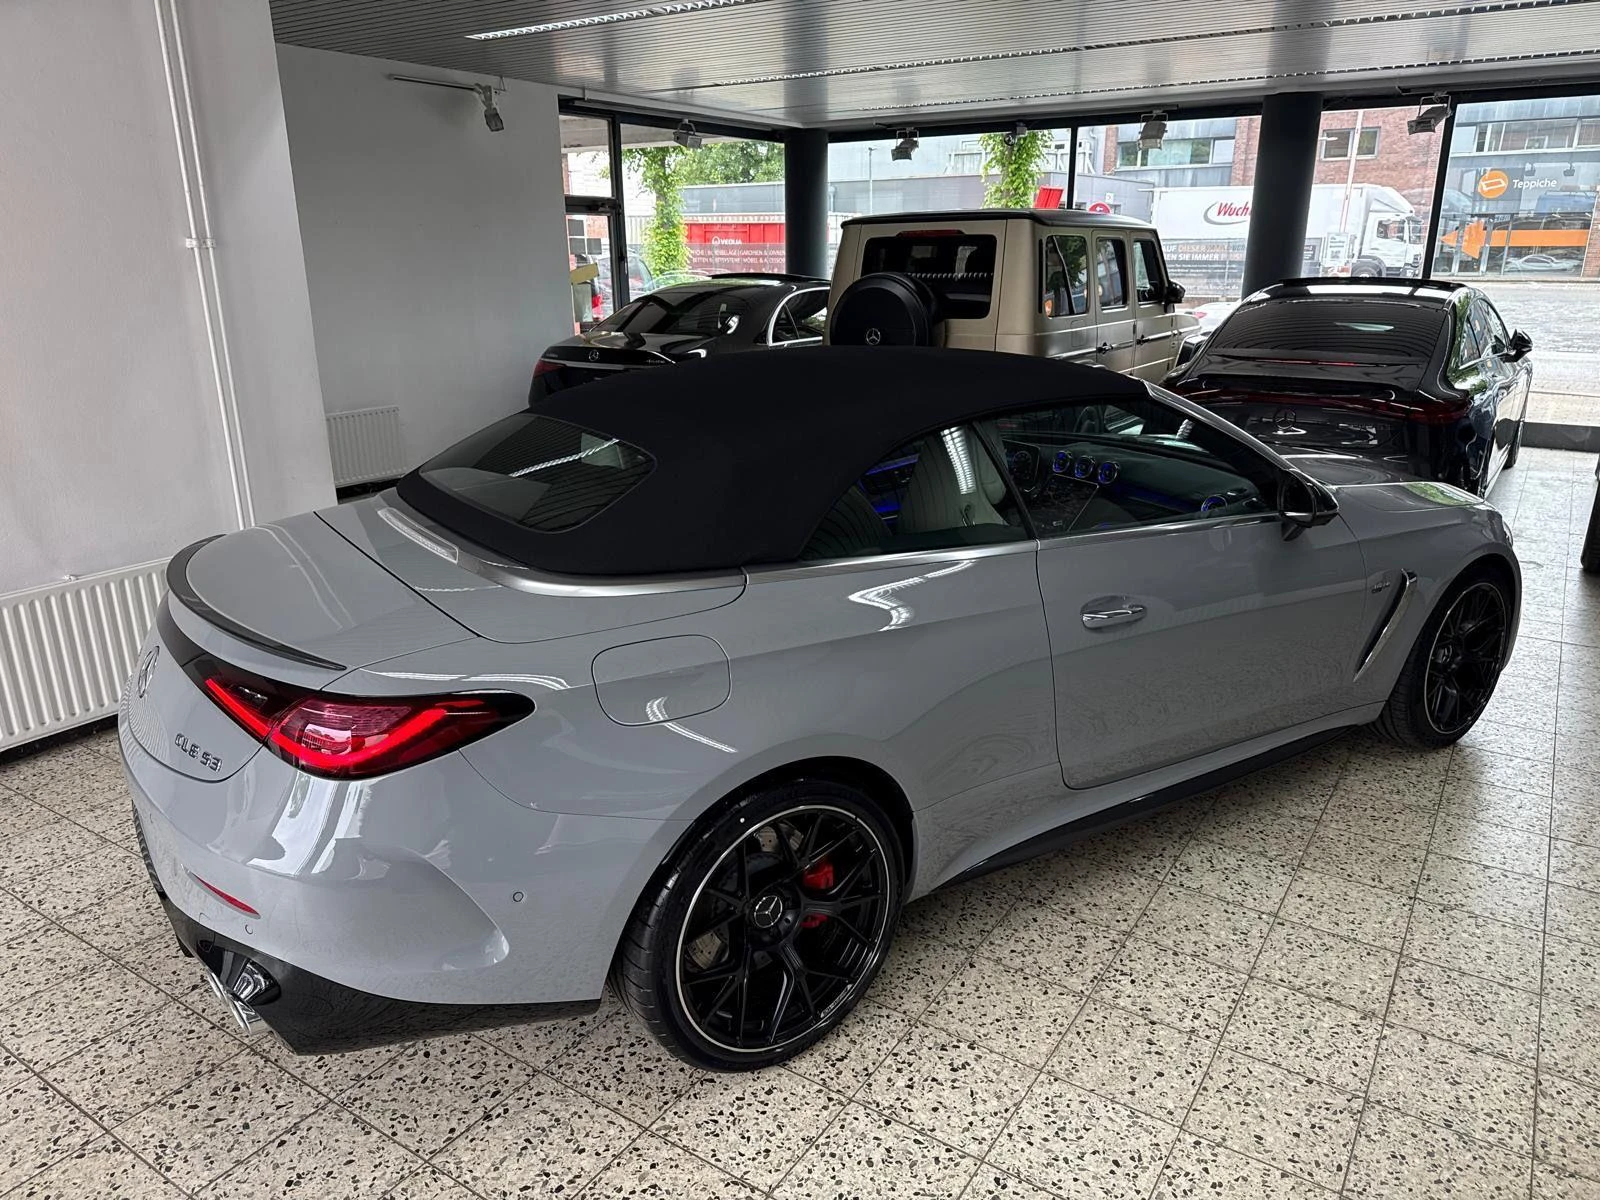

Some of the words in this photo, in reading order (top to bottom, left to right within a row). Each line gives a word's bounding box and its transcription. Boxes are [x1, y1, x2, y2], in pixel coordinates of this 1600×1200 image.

[1512, 177, 1557, 190] Teppiche
[1216, 201, 1251, 217] Wuch
[1191, 253, 1219, 261] IMMER
[174, 733, 201, 759] CLE
[200, 751, 223, 772] 53
